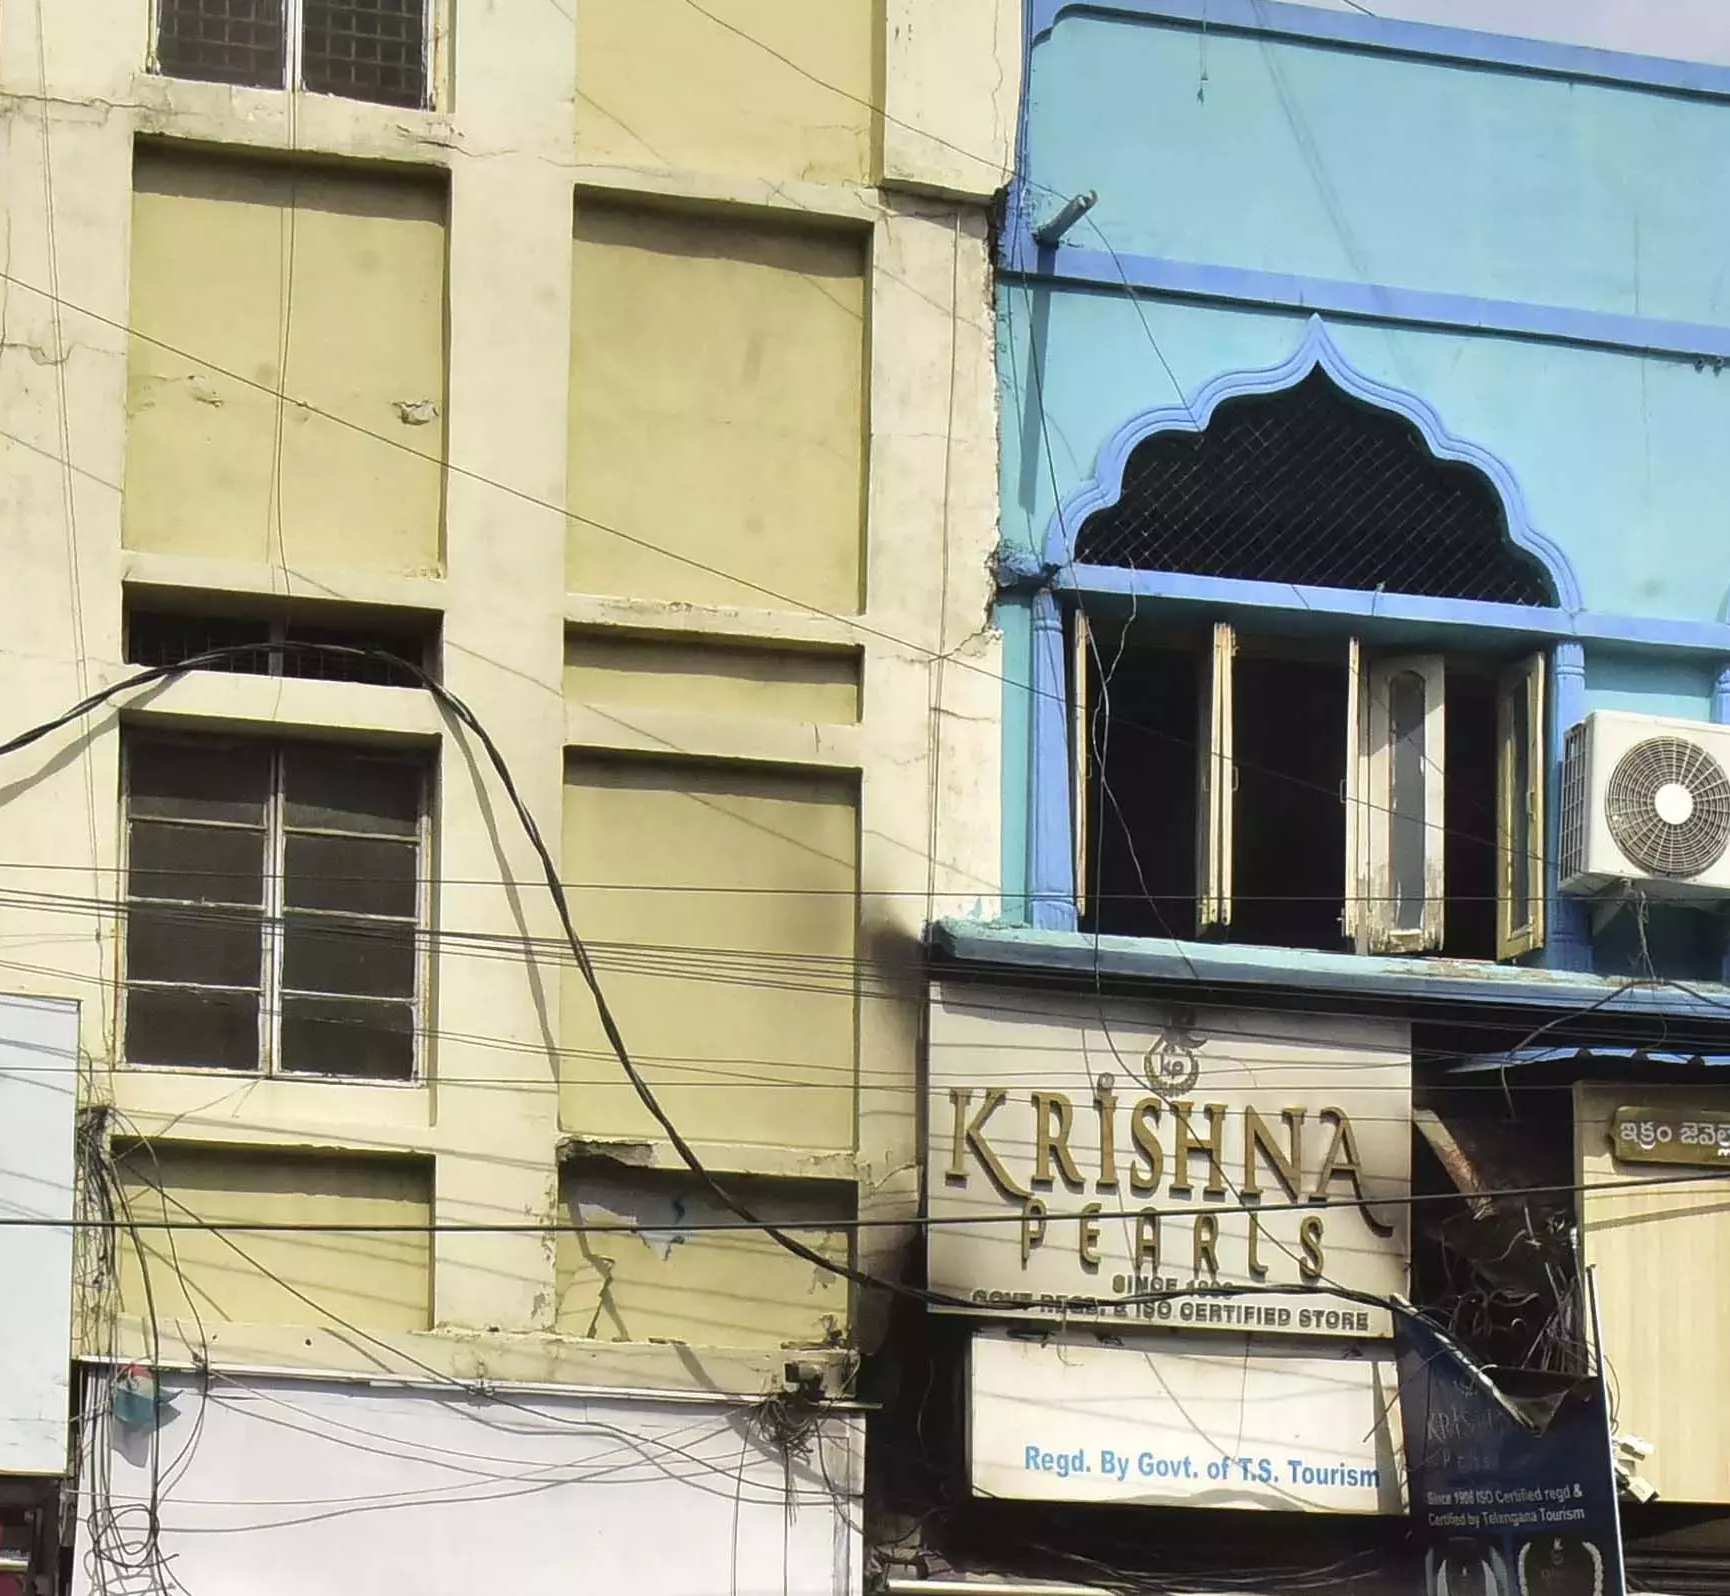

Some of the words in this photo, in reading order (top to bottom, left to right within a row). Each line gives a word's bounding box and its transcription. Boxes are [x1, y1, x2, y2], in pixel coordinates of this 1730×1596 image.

[944, 1072, 1394, 1237] KRISHNA
[1021, 1193, 1325, 1279] PEARLS
[1112, 1274, 1178, 1295] SINCE
[1136, 1301, 1173, 1320] ISO
[1179, 1302, 1292, 1327] CERTIFIED
[1298, 1308, 1369, 1332] STORE
[1024, 1446, 1092, 1475] Regd.
[1100, 1448, 1131, 1479] By
[1137, 1451, 1200, 1480] Govt.
[1207, 1454, 1232, 1481] of
[1236, 1456, 1279, 1484] T.S.
[1287, 1458, 1382, 1489] Tourism
[1495, 1487, 1543, 1505] Certified
[1544, 1485, 1571, 1504] regd
[1572, 1483, 1584, 1498] &
[1428, 1512, 1467, 1527] Certified
[1539, 1506, 1586, 1523] Tourism
